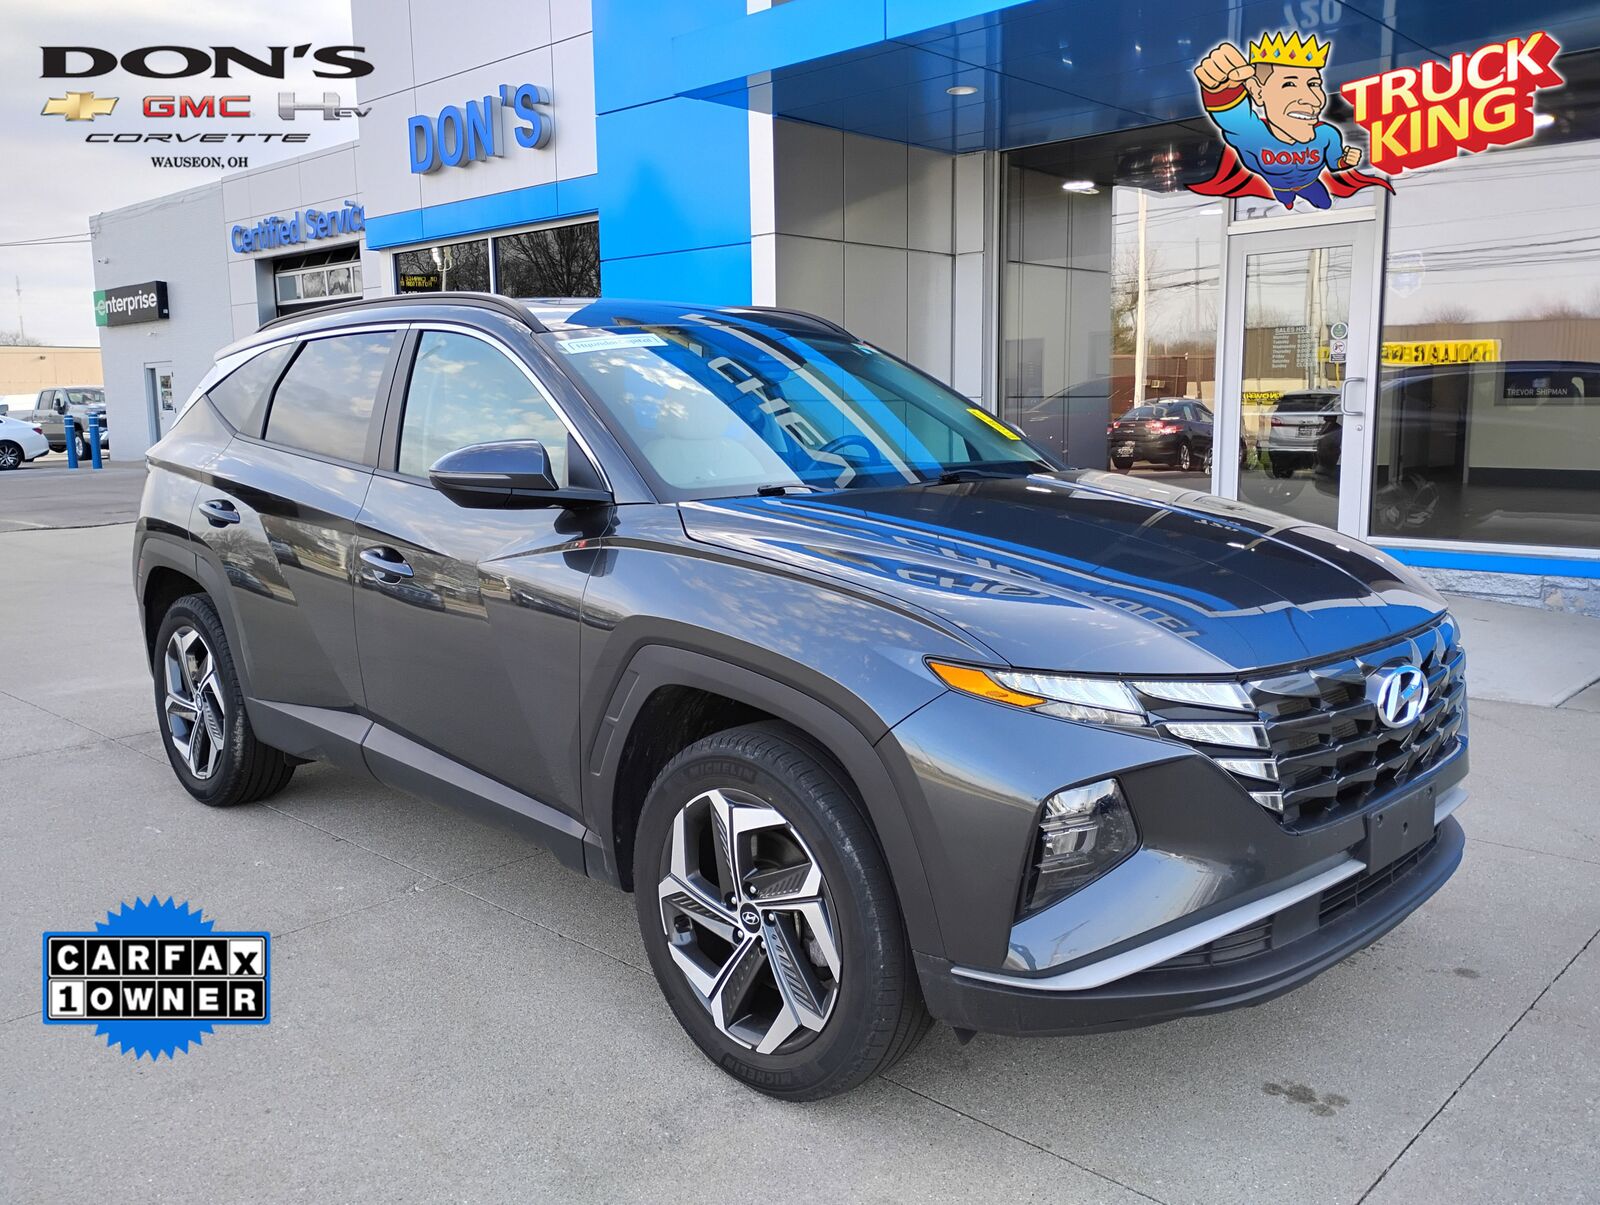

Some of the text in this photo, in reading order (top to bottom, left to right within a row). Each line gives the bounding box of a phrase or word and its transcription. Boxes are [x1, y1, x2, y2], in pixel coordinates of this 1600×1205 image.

[408, 84, 549, 174] DON'S
[231, 199, 365, 253] Certified Servic
[96, 290, 157, 316] enterprise
[1507, 388, 1568, 396] TREVOR SHIPMAN
